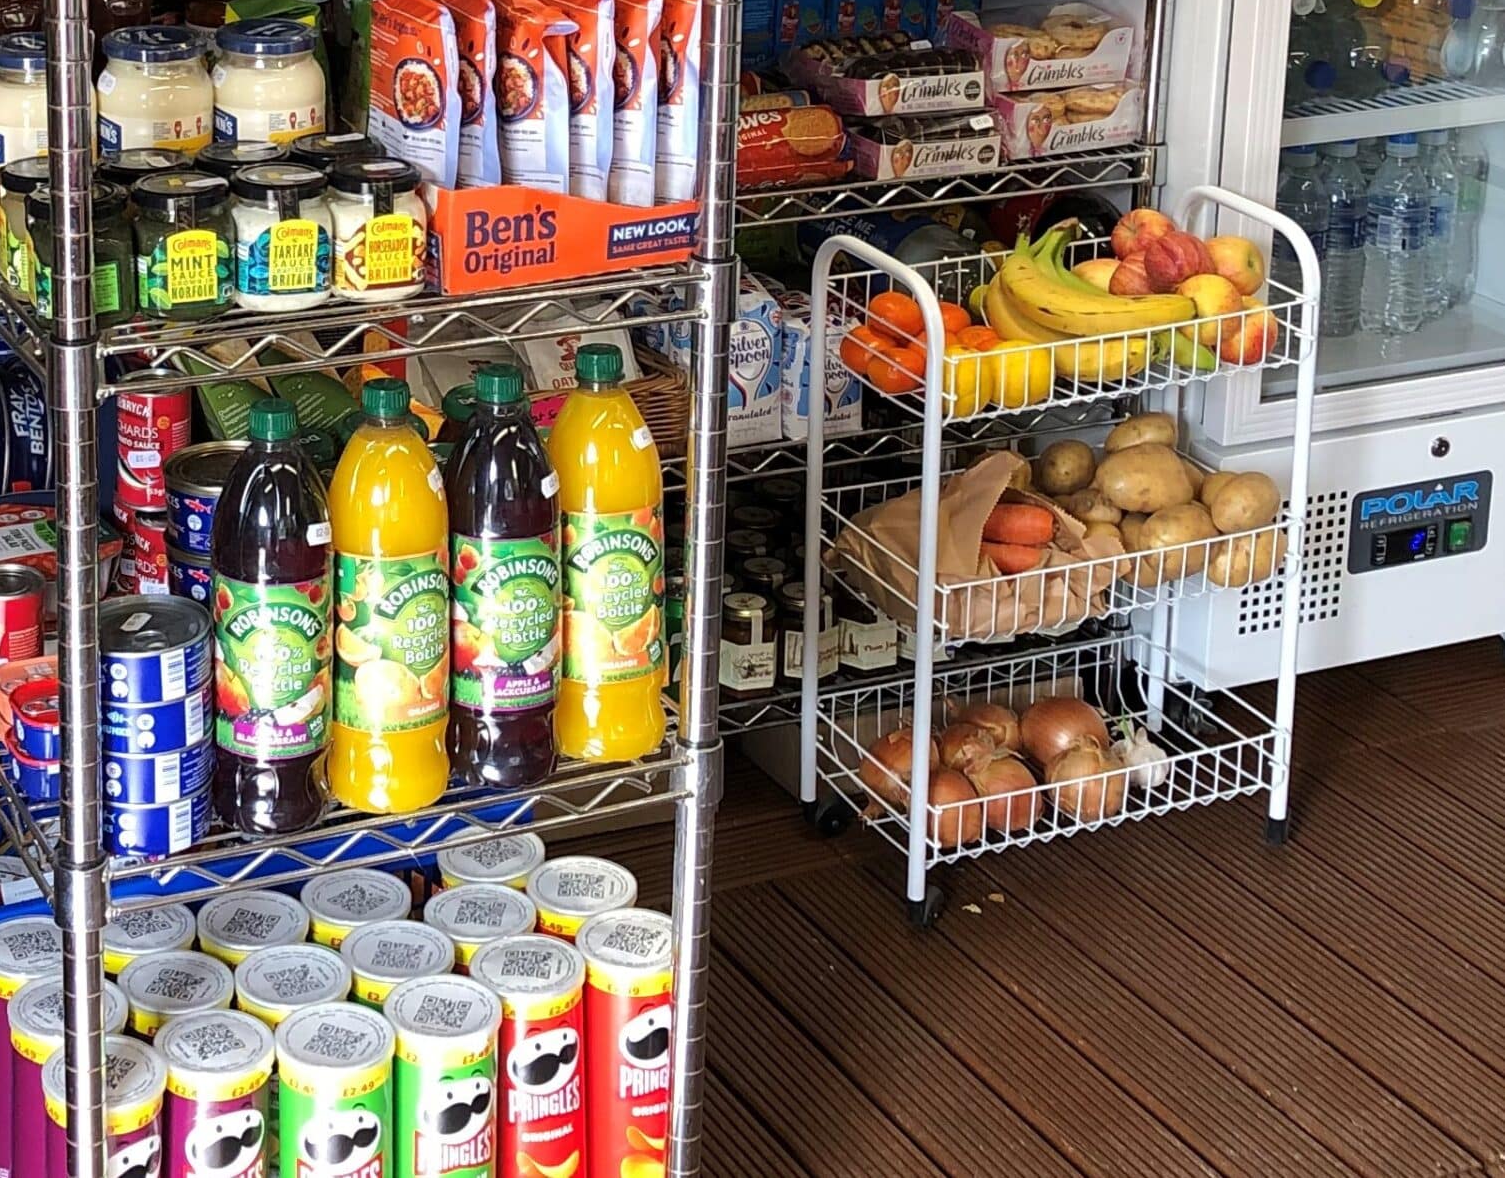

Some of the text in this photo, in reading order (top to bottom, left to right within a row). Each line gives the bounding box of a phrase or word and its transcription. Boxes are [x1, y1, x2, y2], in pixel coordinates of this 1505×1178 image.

[464, 205, 557, 249] Ben's
[613, 217, 692, 242] NEW LOOK,
[170, 255, 213, 271] MINT
[273, 259, 315, 269] SAUCE
[369, 252, 408, 261] SAUCE
[464, 242, 556, 274] Original
[171, 270, 214, 281] SAUCE
[271, 272, 314, 287] BRITAIN
[368, 267, 410, 282] BRITAIN
[1361, 480, 1480, 521] POLAR
[1360, 501, 1479, 531] REFRIGERATION
[573, 531, 657, 572] ROBINSONS
[477, 558, 559, 597] ROBINSONS
[596, 602, 644, 620] Bottle
[501, 624, 548, 643] Bottle
[404, 642, 445, 664] Bottle
[508, 1076, 581, 1124] PRINGLES
